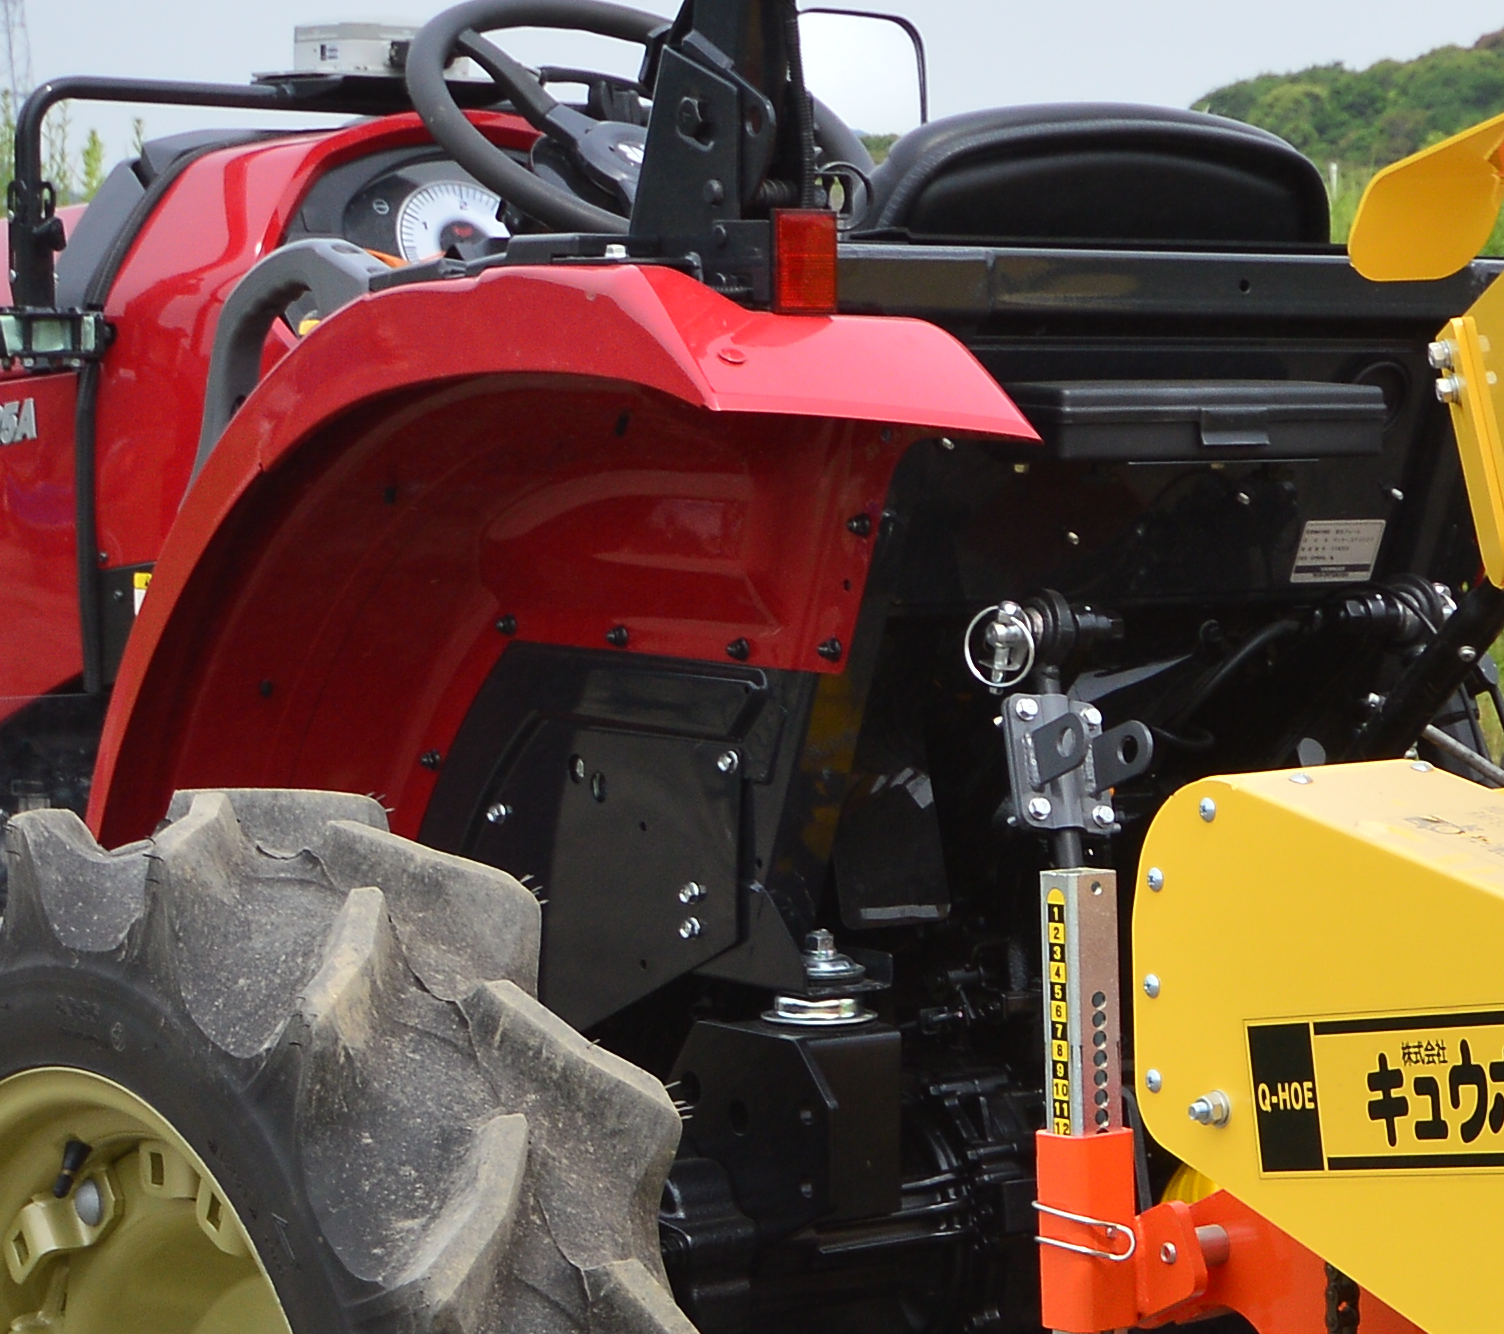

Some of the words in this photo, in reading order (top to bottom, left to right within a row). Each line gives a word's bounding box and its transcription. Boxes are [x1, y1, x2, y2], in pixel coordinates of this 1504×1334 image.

[1053, 907, 1059, 921] 1
[1053, 926, 1060, 940] 2
[1053, 946, 1062, 960] 3
[1055, 966, 1061, 979] 4
[1054, 985, 1063, 999] 5
[1055, 1005, 1062, 1018] 6
[1055, 1023, 1063, 1038] 7
[1057, 1044, 1063, 1057] 8
[1401, 1039, 1448, 1066] 株式会社
[1056, 1063, 1065, 1077] 9
[1054, 1082, 1068, 1097] 10
[1258, 1081, 1315, 1113] Q-HOE
[1054, 1101, 1068, 1117] 11
[1055, 1122, 1070, 1135] 12
